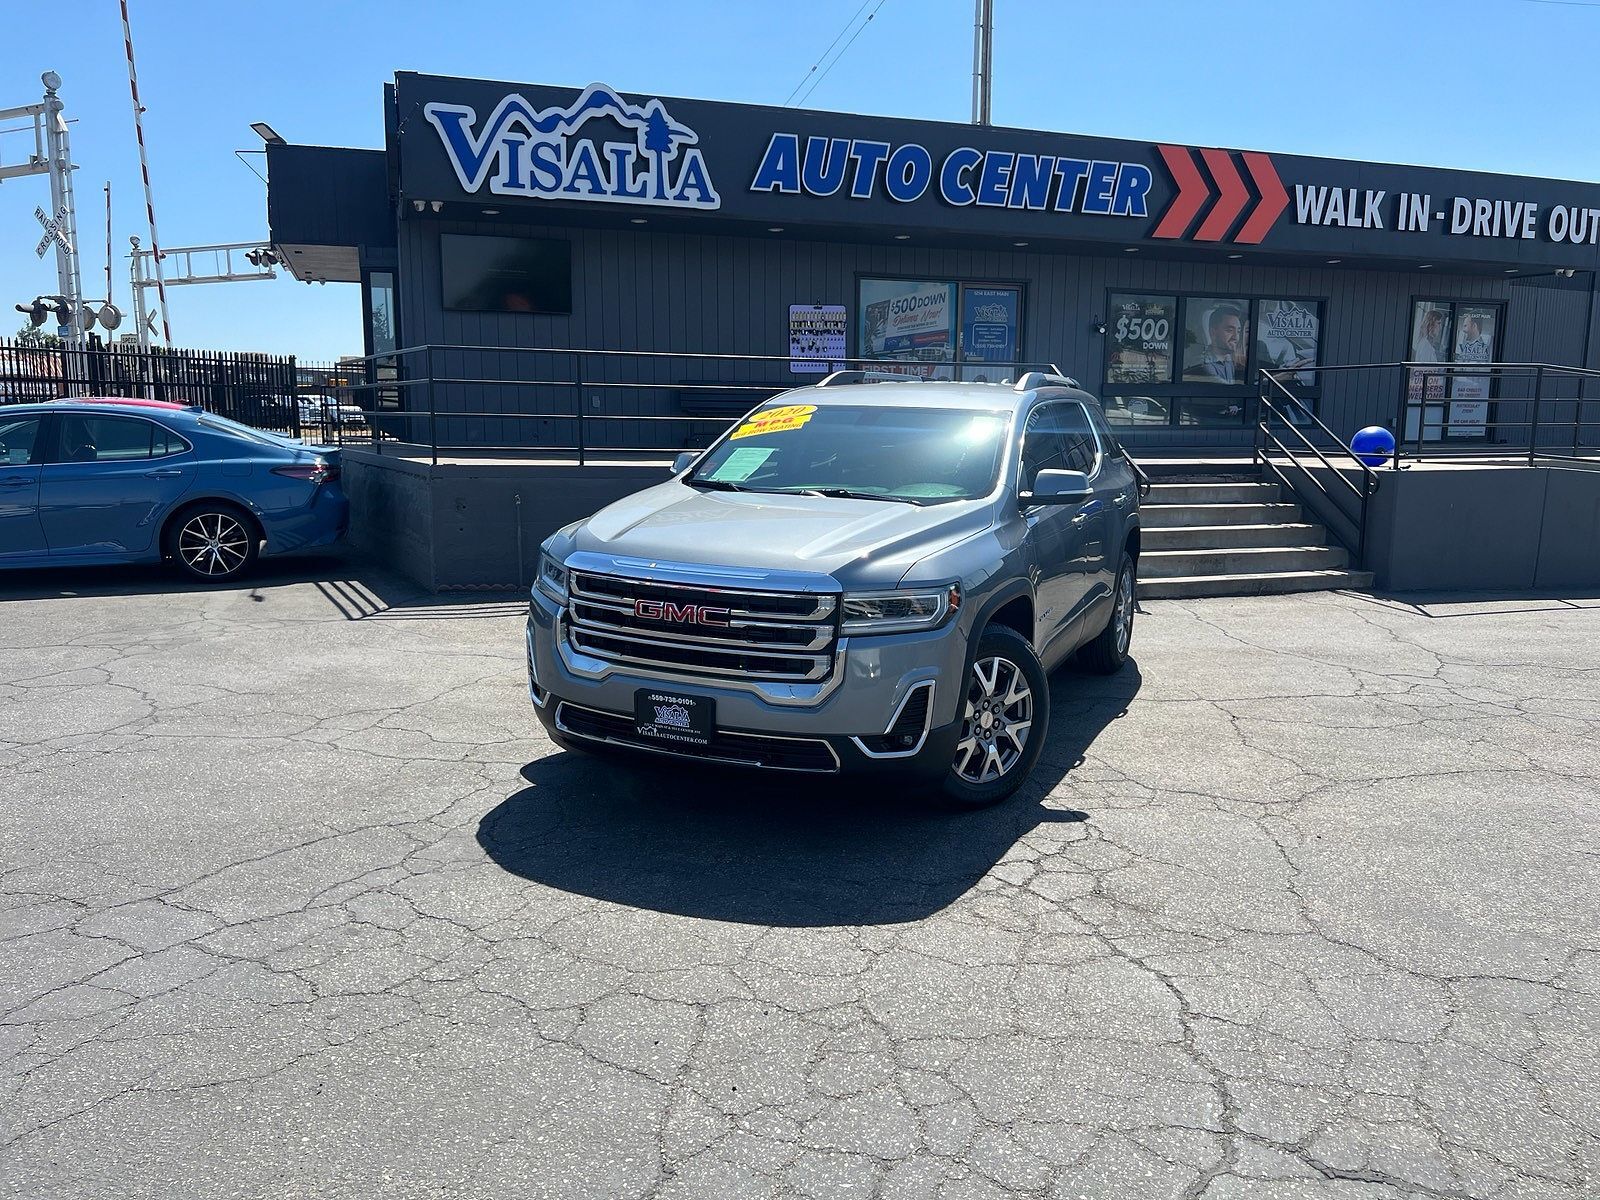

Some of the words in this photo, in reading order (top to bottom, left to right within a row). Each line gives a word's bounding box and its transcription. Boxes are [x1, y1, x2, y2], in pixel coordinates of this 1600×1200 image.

[427, 90, 719, 208] VISALIA
[750, 132, 932, 203] AUTO
[940, 147, 1154, 218] CENTER
[1294, 184, 1386, 230] WALK
[1451, 197, 1537, 240] DRIVE
[1548, 204, 1600, 245] OUT
[36, 205, 68, 257] CROSSING
[890, 296, 917, 315] $500
[917, 292, 946, 308] DOWN
[1114, 315, 1169, 342] $500
[1266, 306, 1315, 330] VISALIA
[1143, 342, 1168, 350] DOWN
[901, 365, 928, 376] TIME
[755, 417, 794, 428] MPG
[759, 406, 807, 420] 2020
[768, 422, 803, 432] SEATING
[634, 599, 729, 628] GMC
